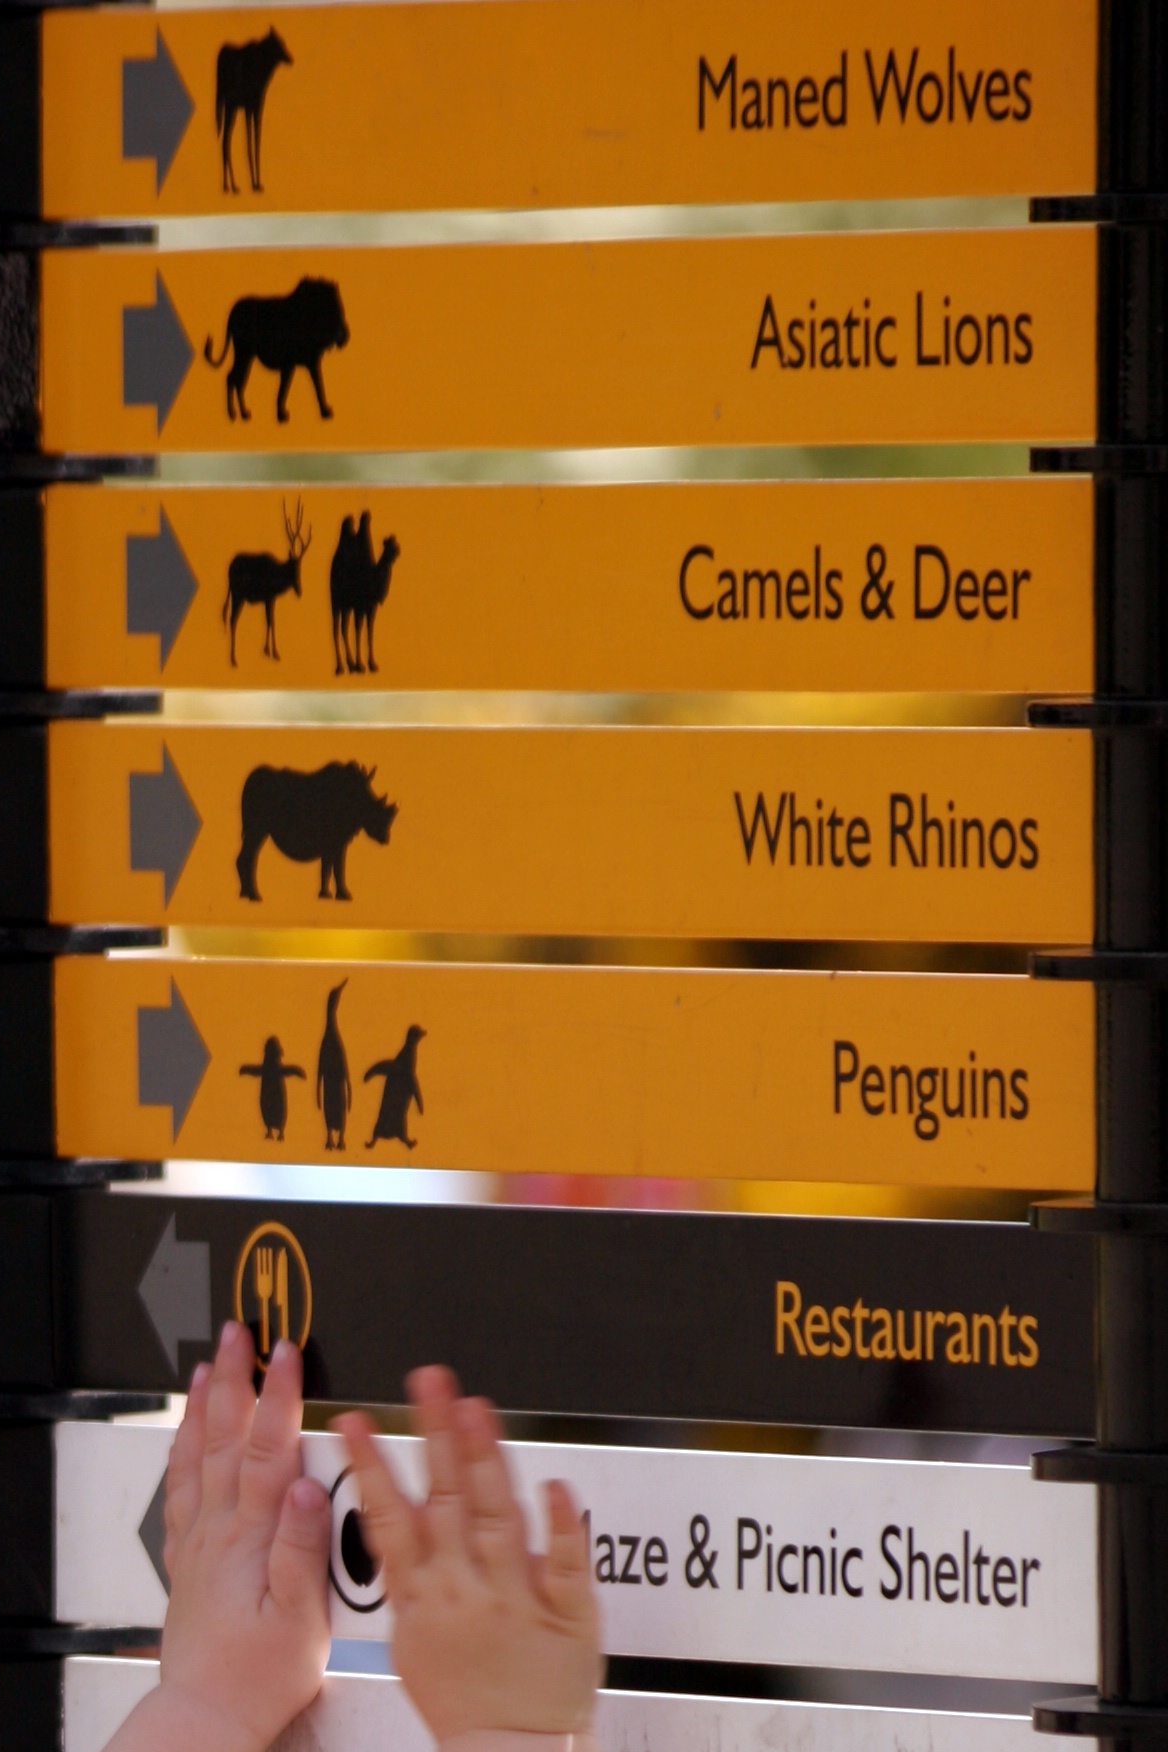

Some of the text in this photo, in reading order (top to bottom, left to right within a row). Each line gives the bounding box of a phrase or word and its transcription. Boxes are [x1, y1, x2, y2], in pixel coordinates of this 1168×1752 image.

[698, 47, 1032, 131] Maned Wolves
[751, 292, 1034, 370] Asiatic Lions
[679, 544, 1032, 621] Camels & Deer
[735, 792, 1039, 870] White Rhinos
[834, 1041, 1030, 1141] Penguins
[776, 1281, 1039, 1367] Restaurants
[582, 1510, 1040, 1607] aze & Picnic Shelter
